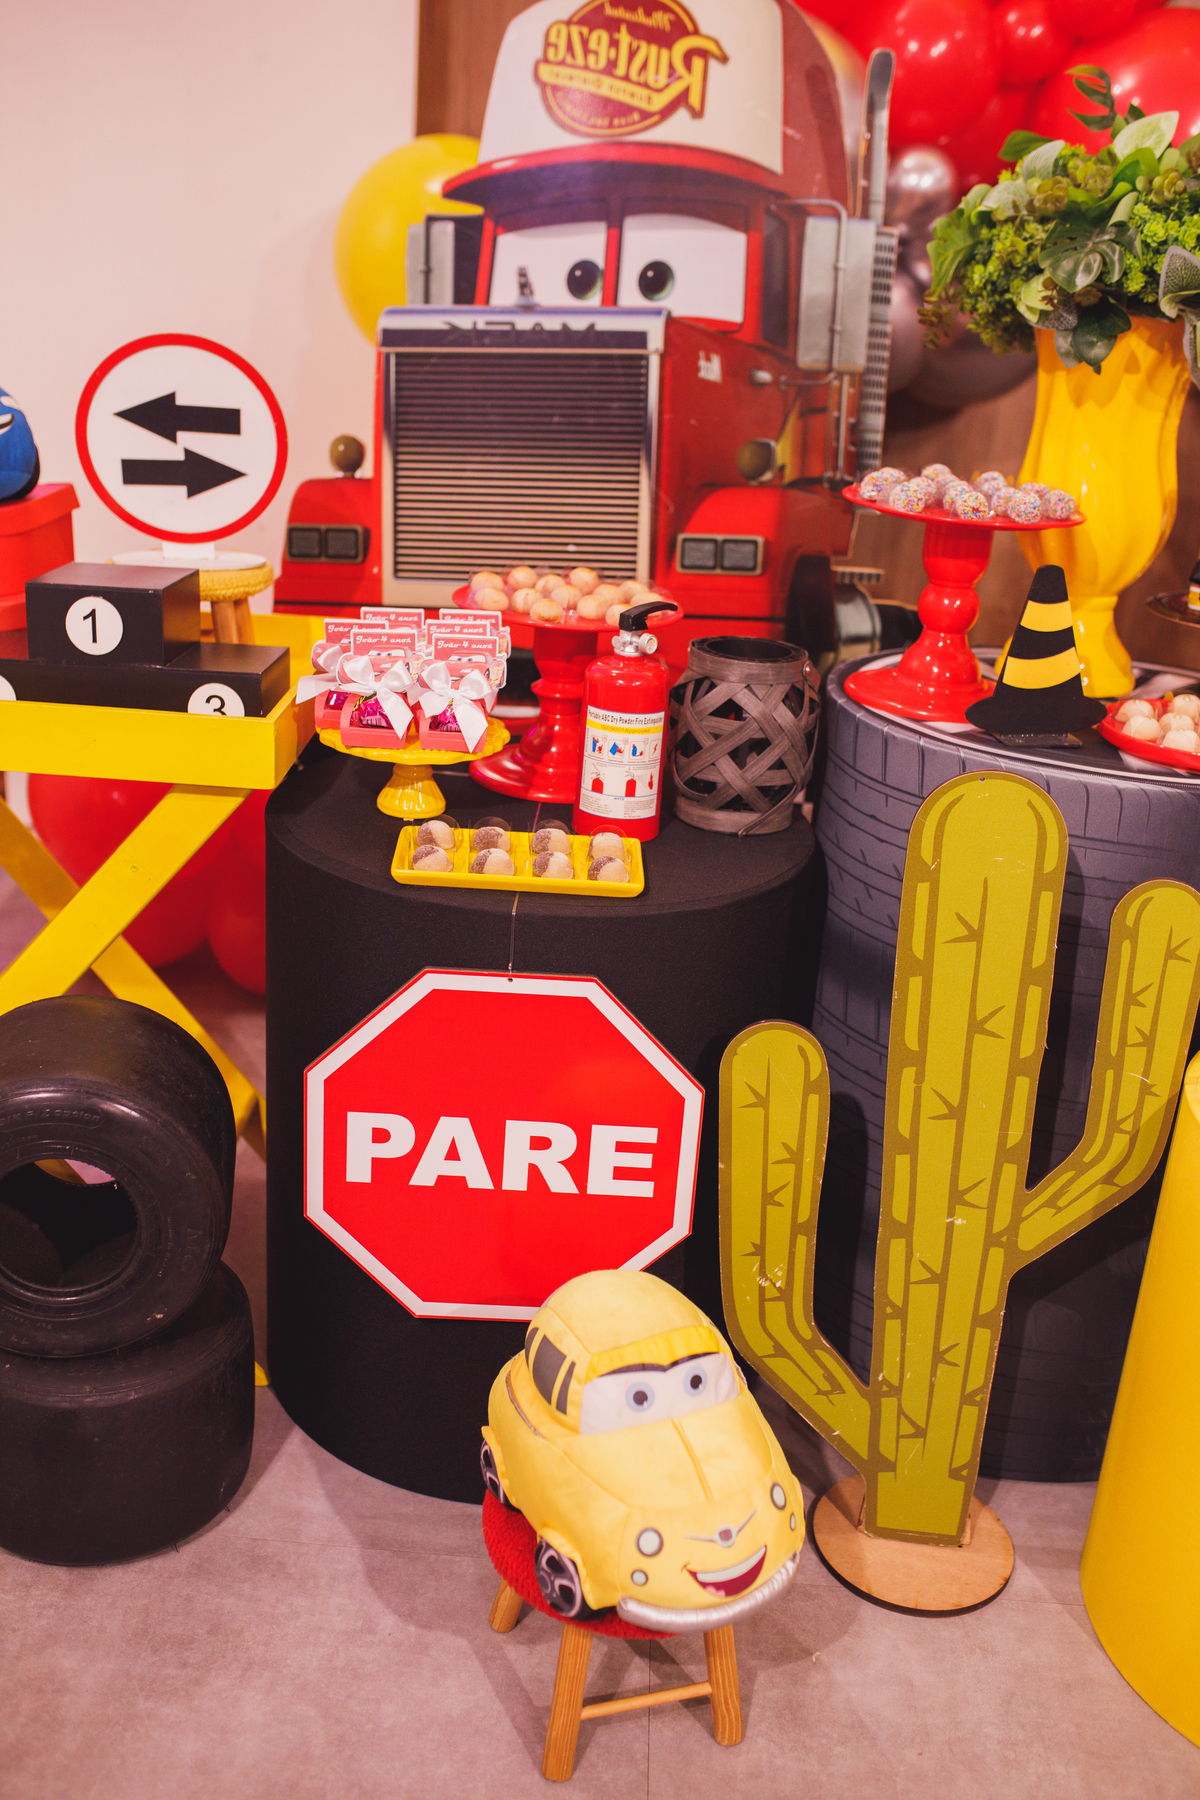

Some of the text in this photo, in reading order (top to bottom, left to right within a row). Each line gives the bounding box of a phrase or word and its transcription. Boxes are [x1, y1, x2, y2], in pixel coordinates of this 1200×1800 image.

[82, 608, 97, 644] 1
[328, 624, 351, 633] João
[430, 625, 453, 634] João
[454, 625, 461, 633] 4
[356, 635, 380, 644] João
[381, 635, 388, 643] 4
[437, 640, 461, 649] João
[204, 695, 227, 716] 3
[602, 713, 610, 722] ABC
[619, 716, 634, 725] Powder
[635, 717, 643, 725] Fire
[55, 1109, 102, 1123] option
[346, 1111, 659, 1198] PARE
